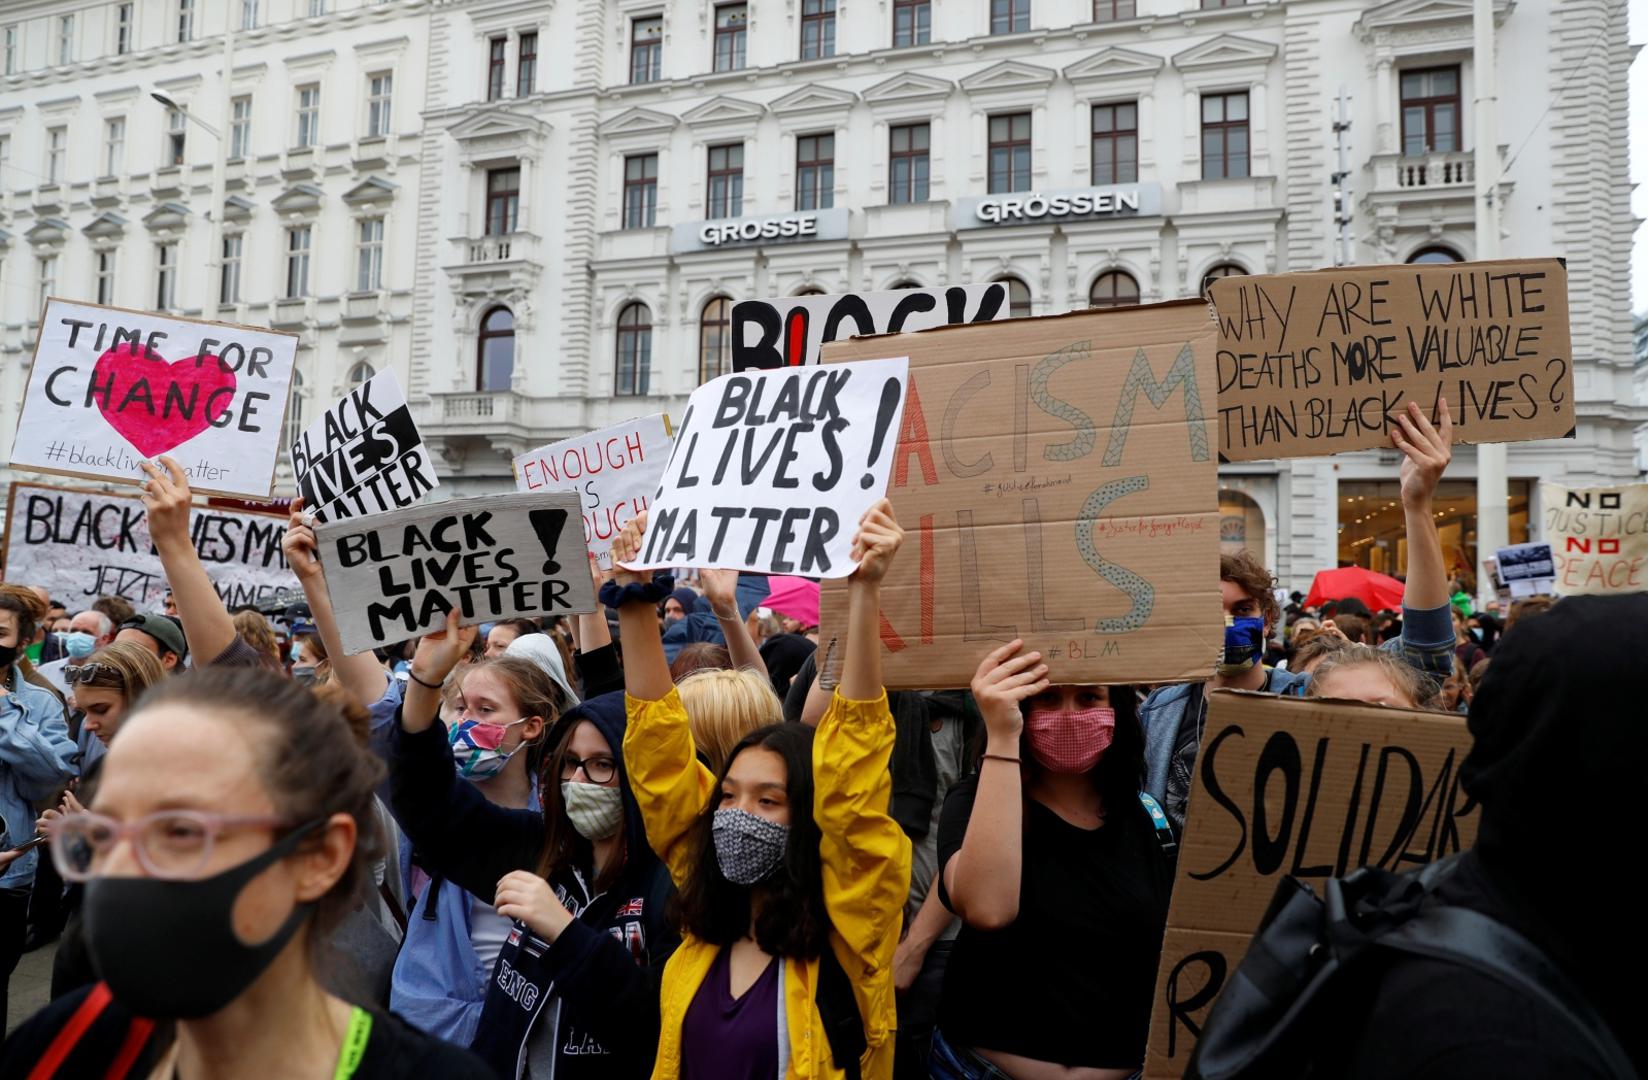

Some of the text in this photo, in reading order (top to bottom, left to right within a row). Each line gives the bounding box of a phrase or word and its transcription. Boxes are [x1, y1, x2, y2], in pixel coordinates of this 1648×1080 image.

[699, 216, 817, 245] GROSSE
[976, 191, 1139, 222] GRÖSSEN
[1209, 272, 1546, 352] WHY ARE WHITE
[61, 318, 274, 379] TIME FOR
[1216, 324, 1543, 394] DEATHS MORE VALUABLE
[45, 366, 270, 432] CHANGE
[712, 368, 852, 429] BLACK
[894, 339, 1210, 488] ACISM
[1218, 400, 1298, 449] THAN
[1305, 389, 1404, 438] BLACK
[46, 440, 229, 481] #blacklivsatter
[291, 380, 384, 482] BLACK
[523, 431, 644, 490] ENOUGH
[575, 480, 600, 508] S
[1566, 491, 1621, 510] NO
[25, 495, 145, 553] BLACK
[336, 511, 497, 568] BLACK
[643, 506, 839, 574] MATTER
[1566, 536, 1620, 555] NO
[378, 547, 520, 597] LIVES
[879, 475, 1155, 653] ILLS
[1553, 553, 1644, 588] PEACE
[367, 579, 573, 641] MATTER
[1188, 724, 1479, 881] SOLIDAR
[497, 959, 539, 1011] ENG
